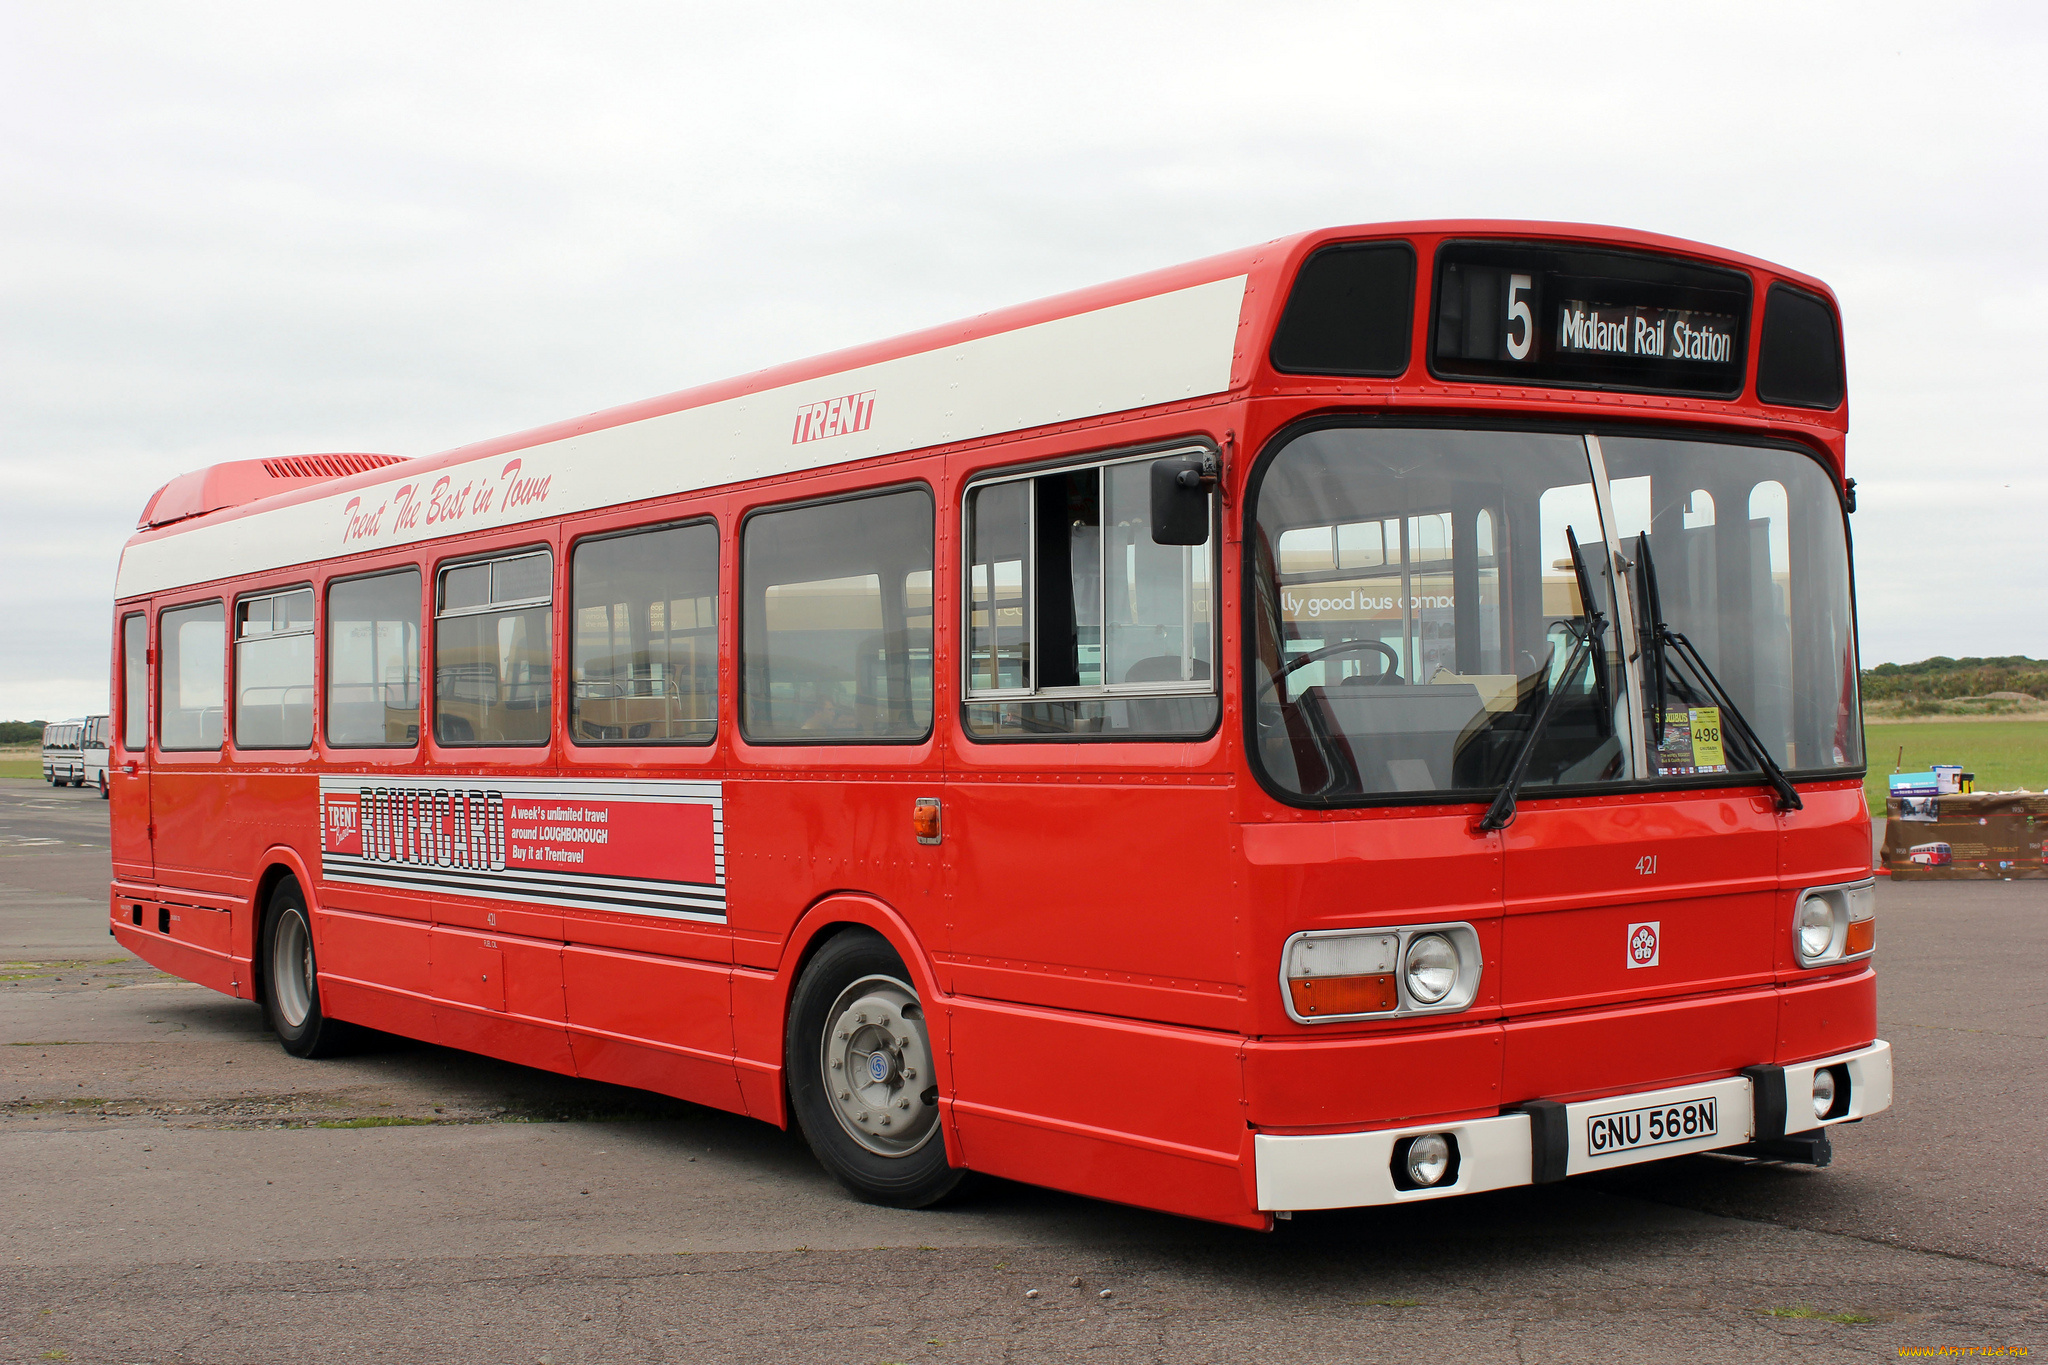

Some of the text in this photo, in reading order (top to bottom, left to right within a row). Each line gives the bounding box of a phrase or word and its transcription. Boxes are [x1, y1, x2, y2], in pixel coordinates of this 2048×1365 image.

[1507, 274, 1533, 360] 5
[1562, 309, 1731, 362] Midland Rail Station
[796, 391, 876, 443] TRENT
[343, 458, 551, 544] Trent The Best in Town
[1308, 591, 1355, 617] good
[1360, 592, 1393, 609] bus
[1695, 728, 1719, 742] 498
[328, 806, 357, 827] TRENT
[511, 805, 608, 823] A week's unlimited travel
[360, 786, 506, 872] ROVERCARD
[511, 826, 608, 844] around LOUGHBOROUGH
[512, 845, 584, 863] Buy it at Trentravel
[1635, 855, 1657, 875] 421
[1591, 1101, 1715, 1150] GNU 568N
